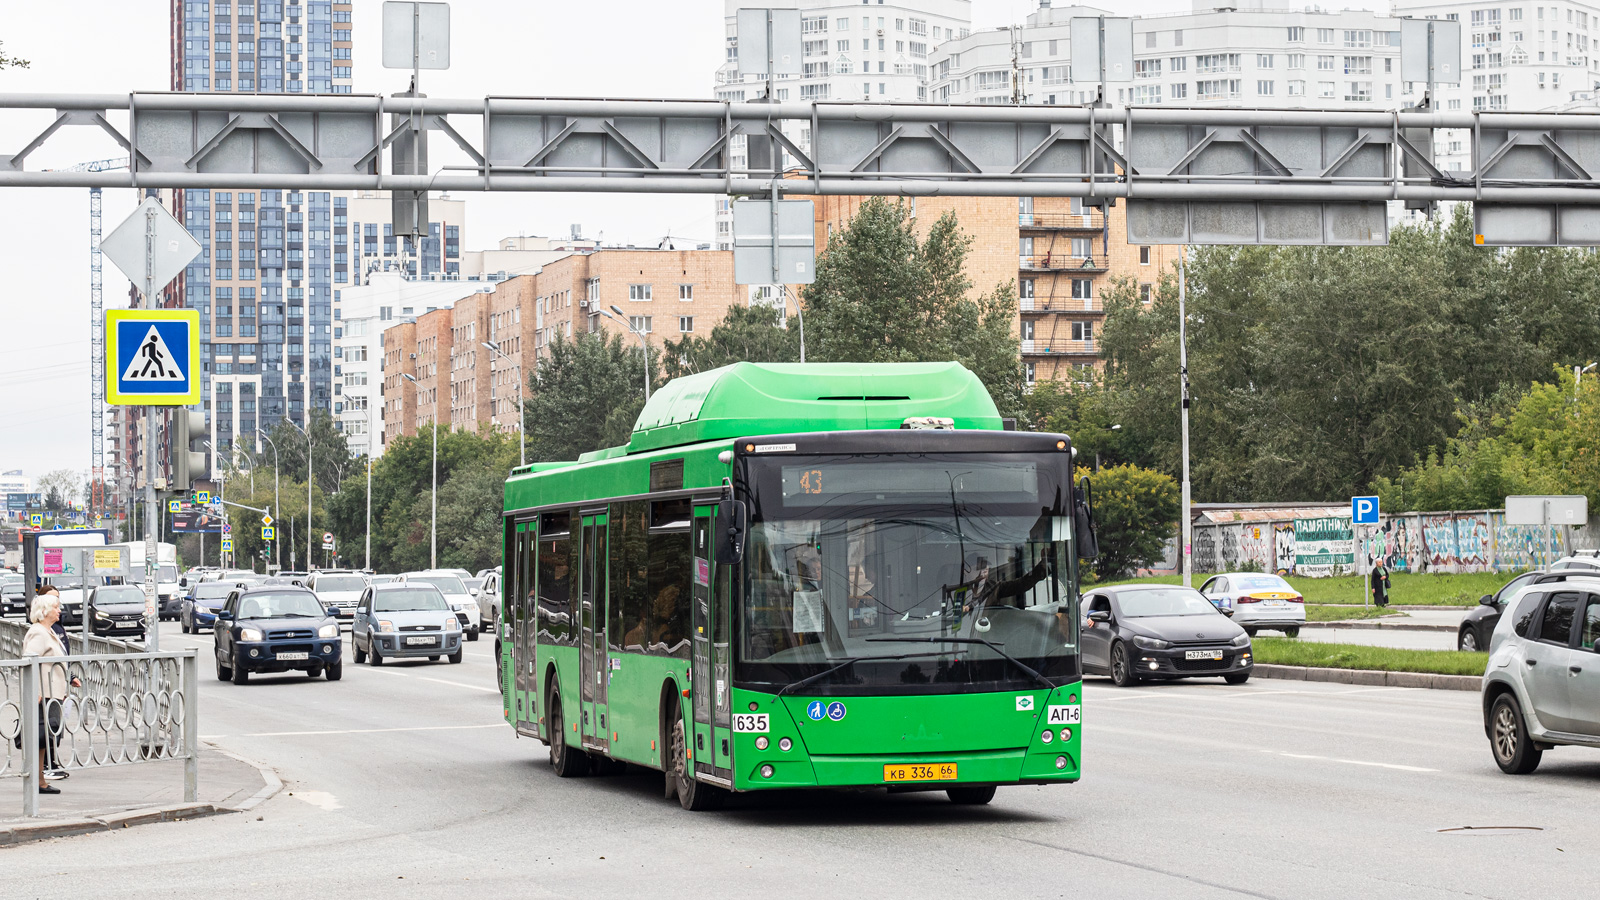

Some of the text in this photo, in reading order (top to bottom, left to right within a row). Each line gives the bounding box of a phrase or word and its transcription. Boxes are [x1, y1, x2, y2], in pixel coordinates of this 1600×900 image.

[800, 470, 822, 494] 43
[1357, 499, 1373, 521] P
[1296, 519, 1352, 532] ПАМЯТНИКИ
[1051, 708, 1079, 721] АП-6
[891, 766, 952, 779] КВ 336 66
